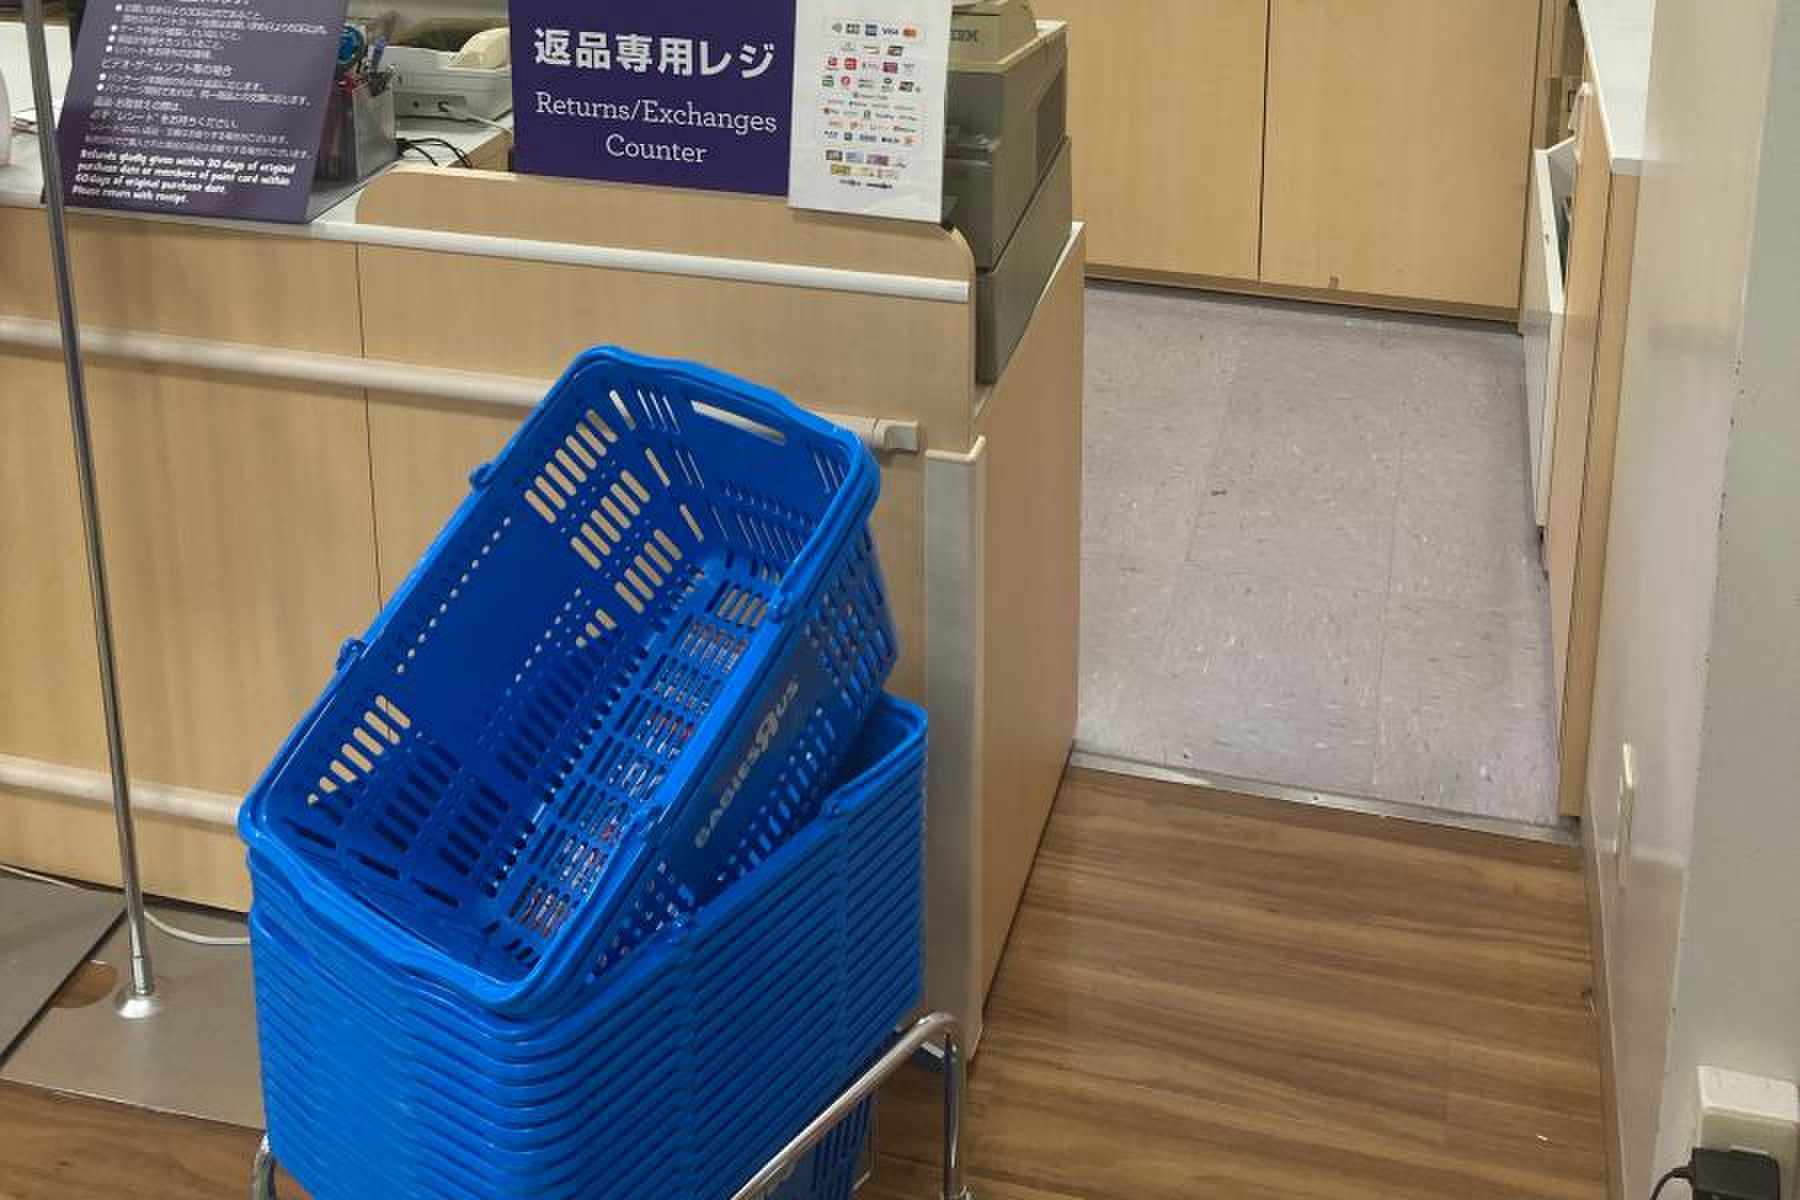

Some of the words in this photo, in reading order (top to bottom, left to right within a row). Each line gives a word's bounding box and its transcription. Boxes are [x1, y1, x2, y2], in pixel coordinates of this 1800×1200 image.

[533, 27, 775, 81] 返品専用レジ
[535, 91, 777, 135] Returns/Exchanges
[222, 160, 246, 173] days
[247, 161, 259, 171] of
[260, 163, 297, 175] original
[606, 134, 708, 164] Counter
